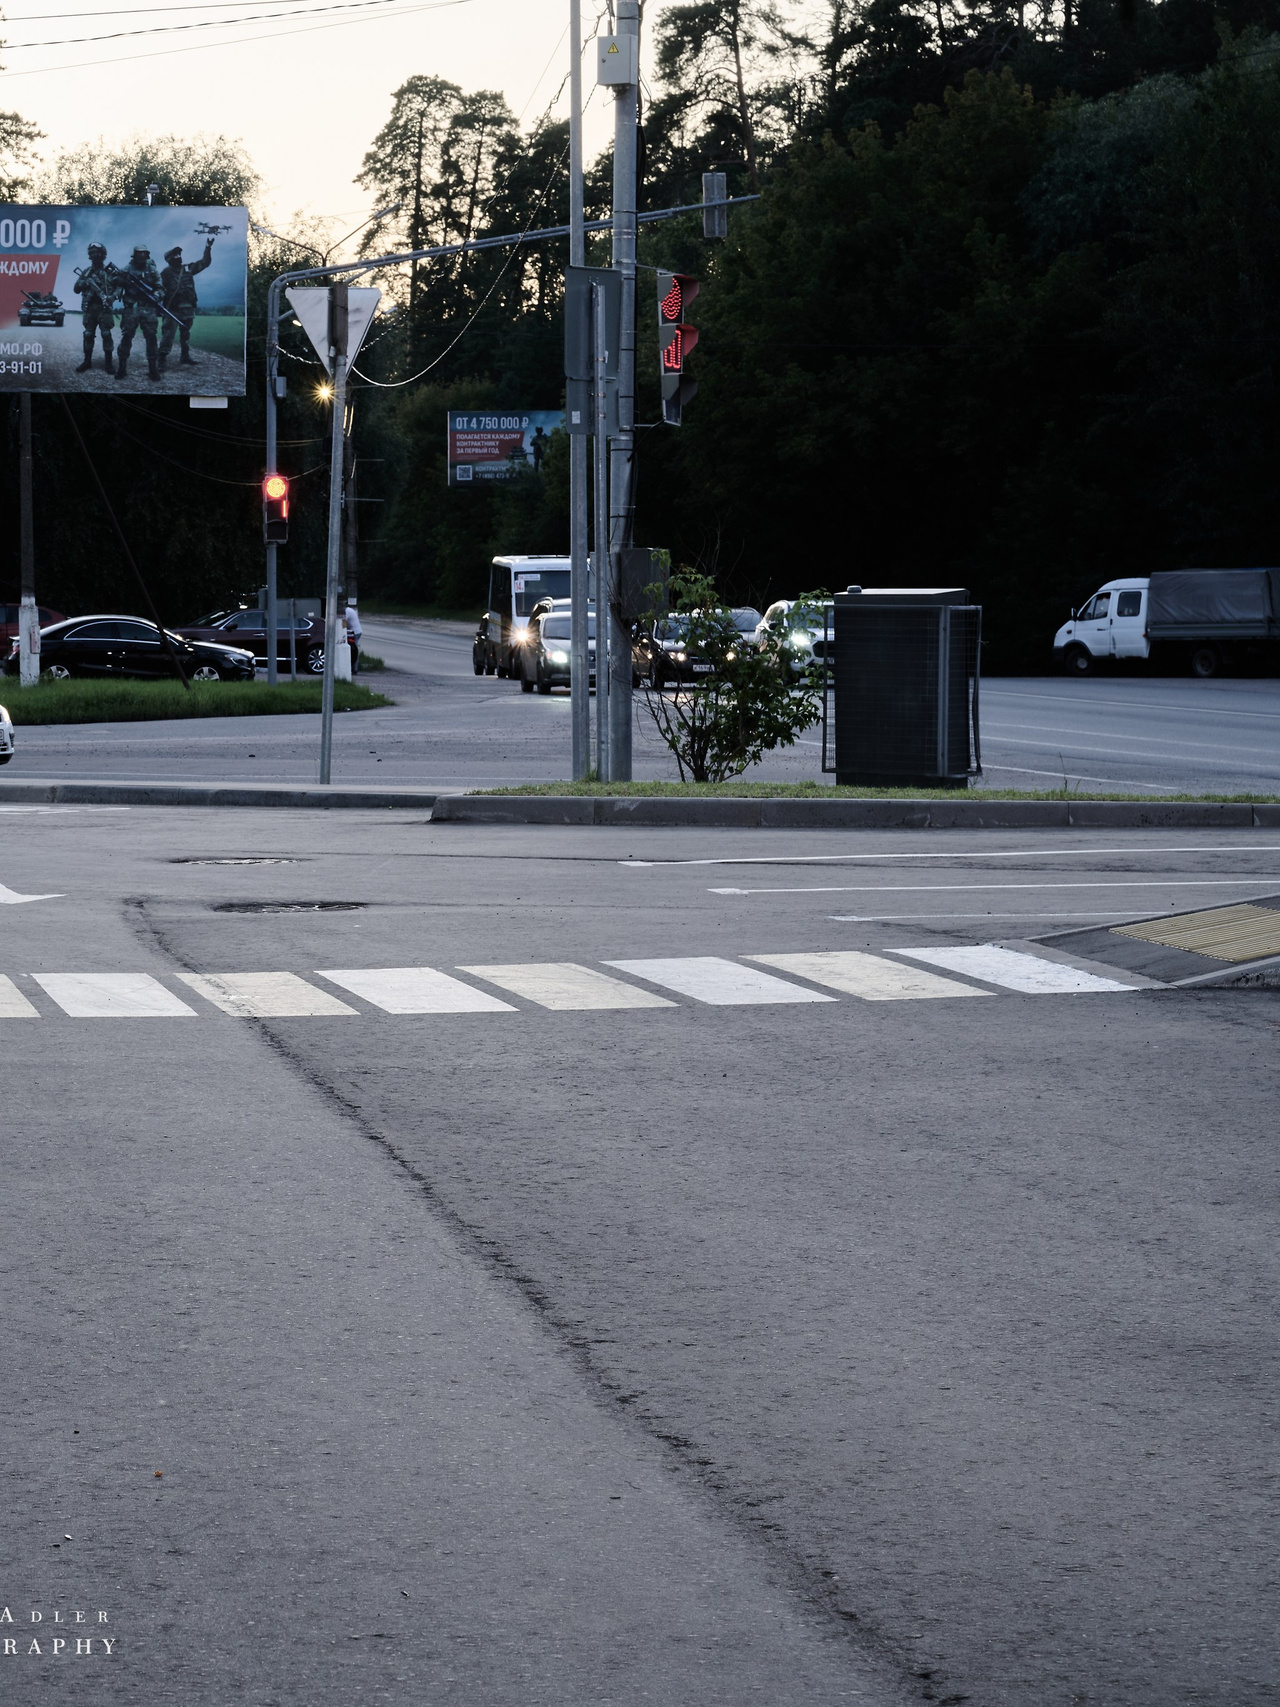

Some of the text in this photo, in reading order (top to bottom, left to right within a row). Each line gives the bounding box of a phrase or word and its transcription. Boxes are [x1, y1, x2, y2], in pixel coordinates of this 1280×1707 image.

[0, 218, 47, 248] 000
[456, 417, 469, 430] ОТ
[470, 417, 478, 429] 4
[479, 417, 499, 429] 750
[500, 417, 520, 429] 000
